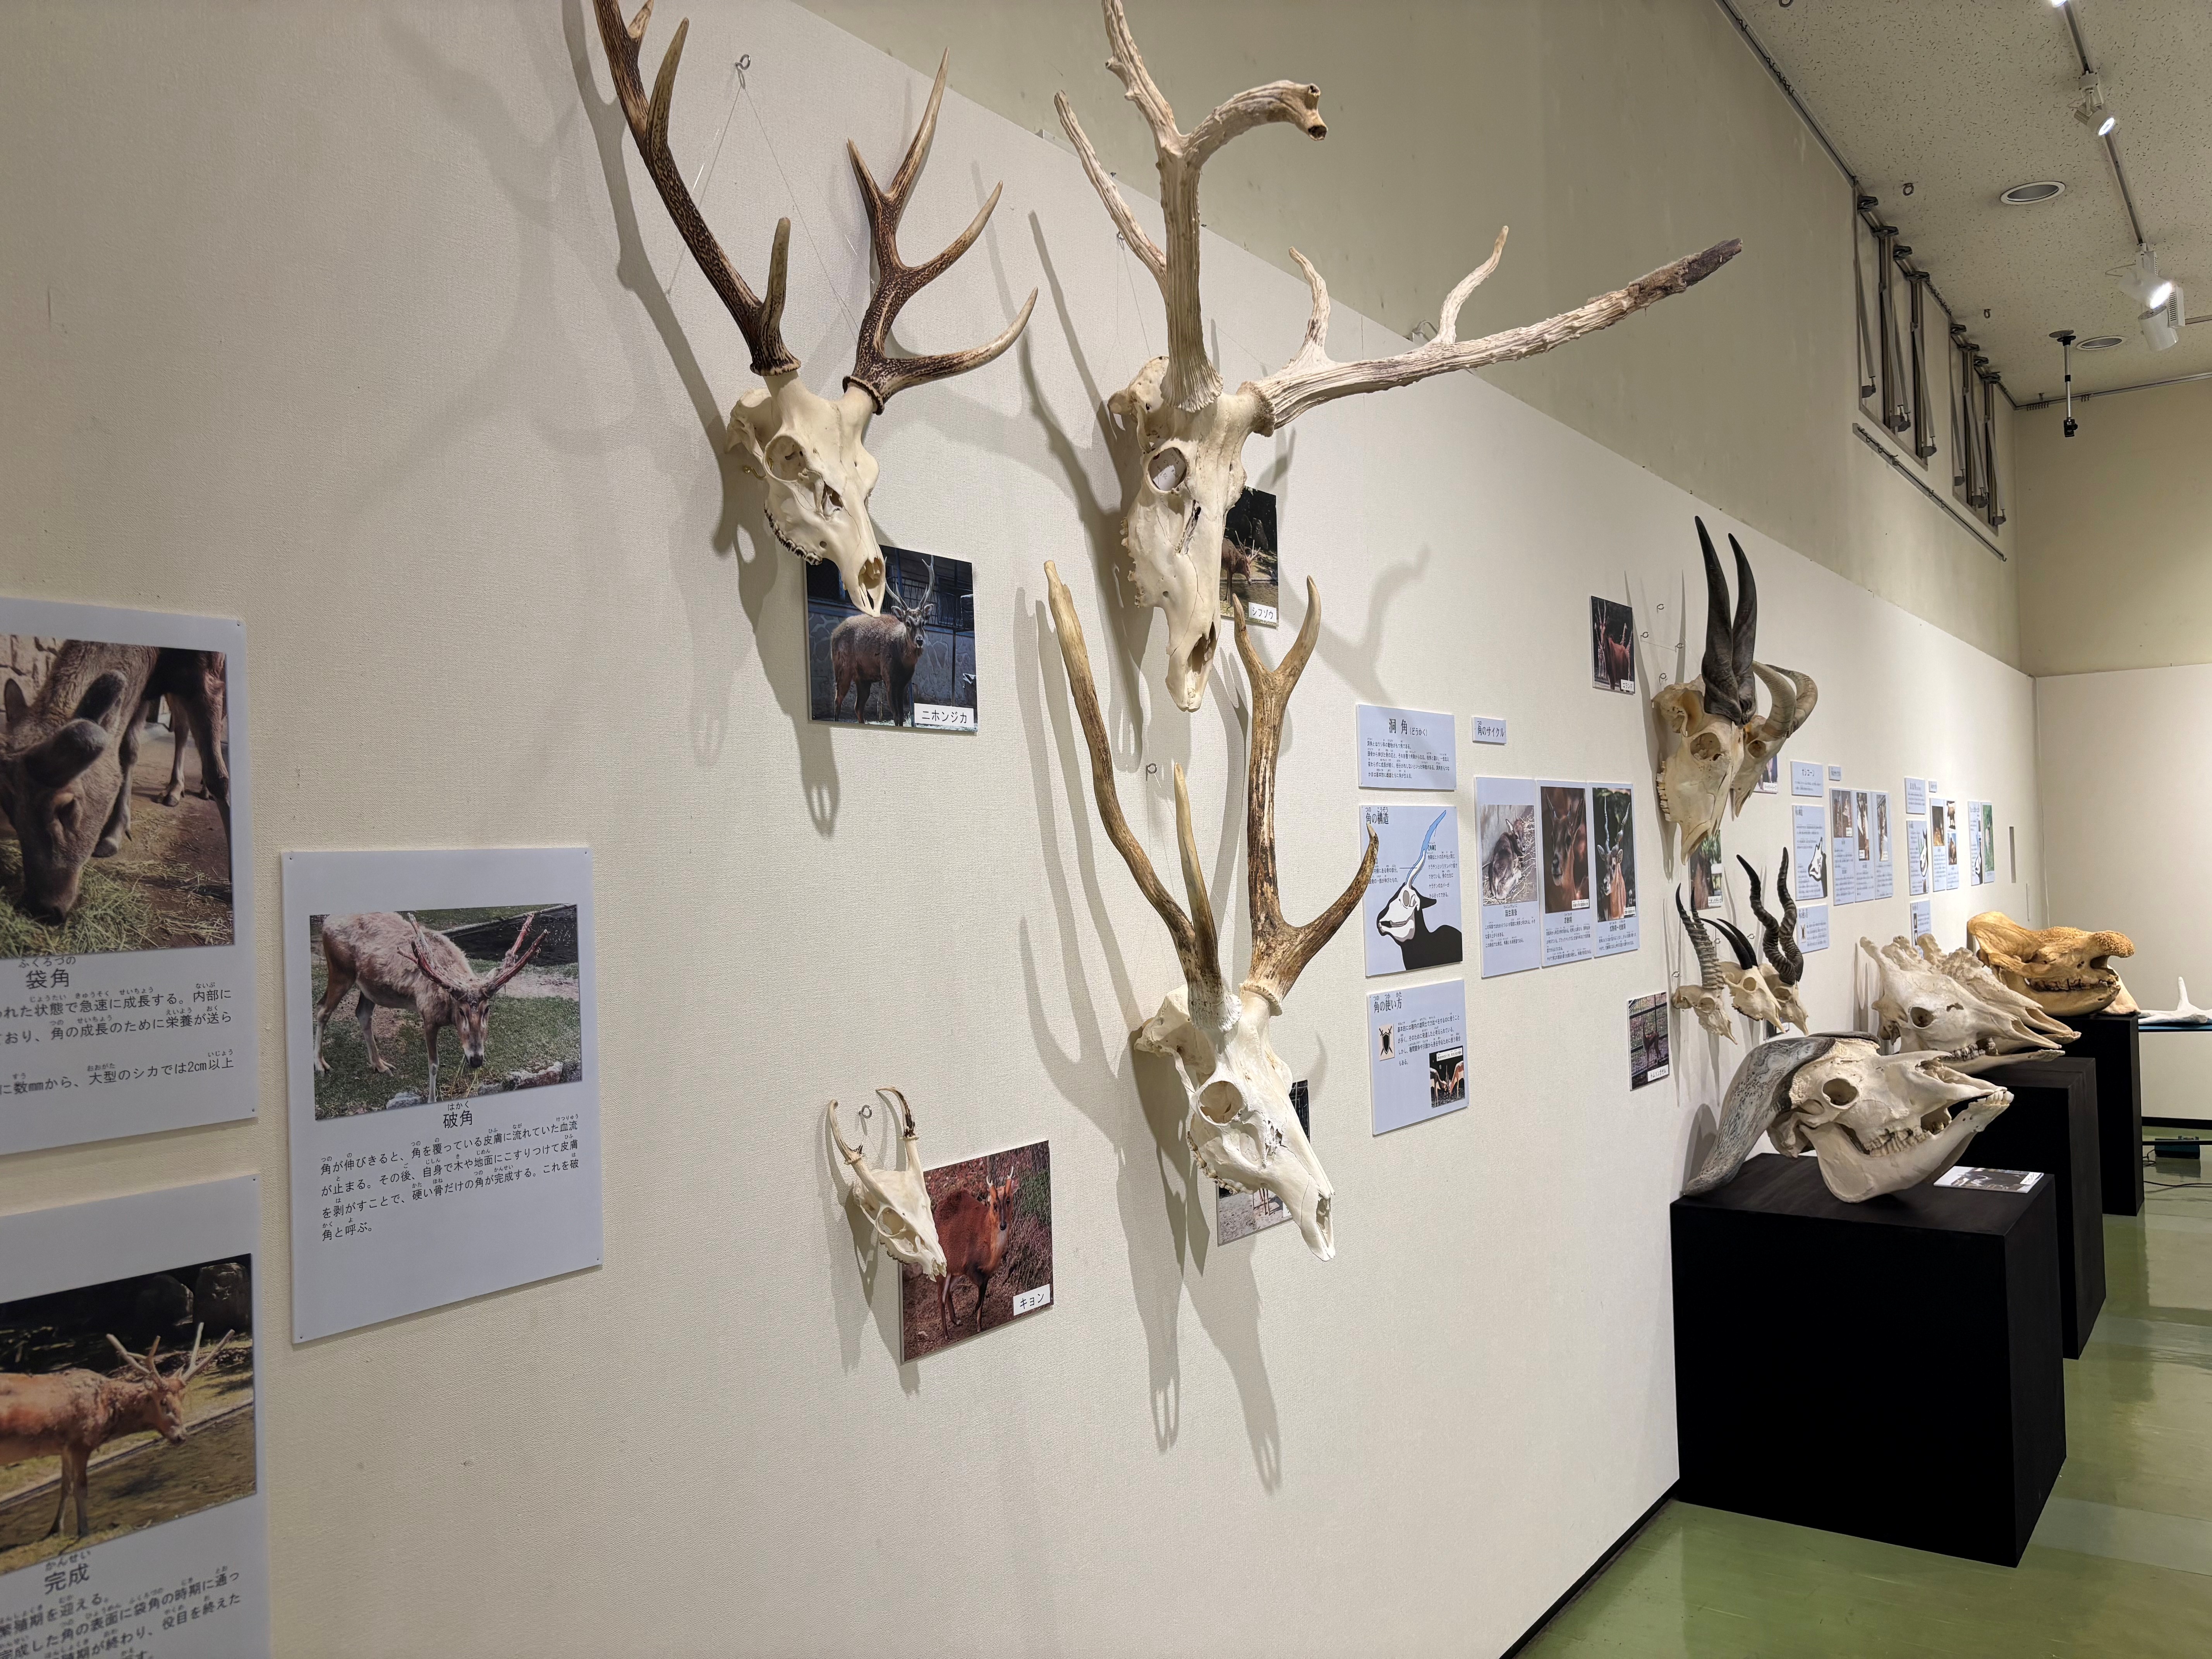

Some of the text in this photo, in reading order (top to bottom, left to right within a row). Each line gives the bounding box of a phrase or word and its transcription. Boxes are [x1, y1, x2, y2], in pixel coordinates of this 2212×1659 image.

[921, 709, 968, 724] ニホンジカ
[1477, 725, 1504, 737] 角のサイクル
[1366, 812, 1389, 824] 角の構造
[19, 956, 76, 968] ふくろづの
[26, 968, 69, 989] 袋角
[76, 991, 109, 999] きゅうそく
[119, 986, 153, 995] せいちょう
[0, 989, 232, 1018] れた状態で急速に成長する。内部に
[1374, 997, 1402, 1013] 角の使い方
[77, 1015, 112, 1024] せいちょう
[166, 1007, 192, 1015] えいよう
[0, 1012, 231, 1044] おり、角の成長のために栄養が送ら
[87, 1063, 115, 1072] おおがた
[447, 1100, 469, 1111] はかく
[443, 1109, 472, 1129] 破角
[556, 1113, 579, 1122] けつりゅう
[320, 1120, 578, 1176] 角が伸びきると、角を覆っている皮膚に流れていた血流
[321, 1139, 578, 1197] が止まる。その後、自身で木や地面にこすりつけて皮膚
[494, 1164, 514, 1172] かんせい
[322, 1158, 579, 1219] を剥がすことで、硬い骨だけの角が完成する。これを破
[322, 1222, 373, 1242] 角と呼ぶ。
[1020, 1293, 1044, 1309] キョン
[44, 1563, 90, 1595] 完成
